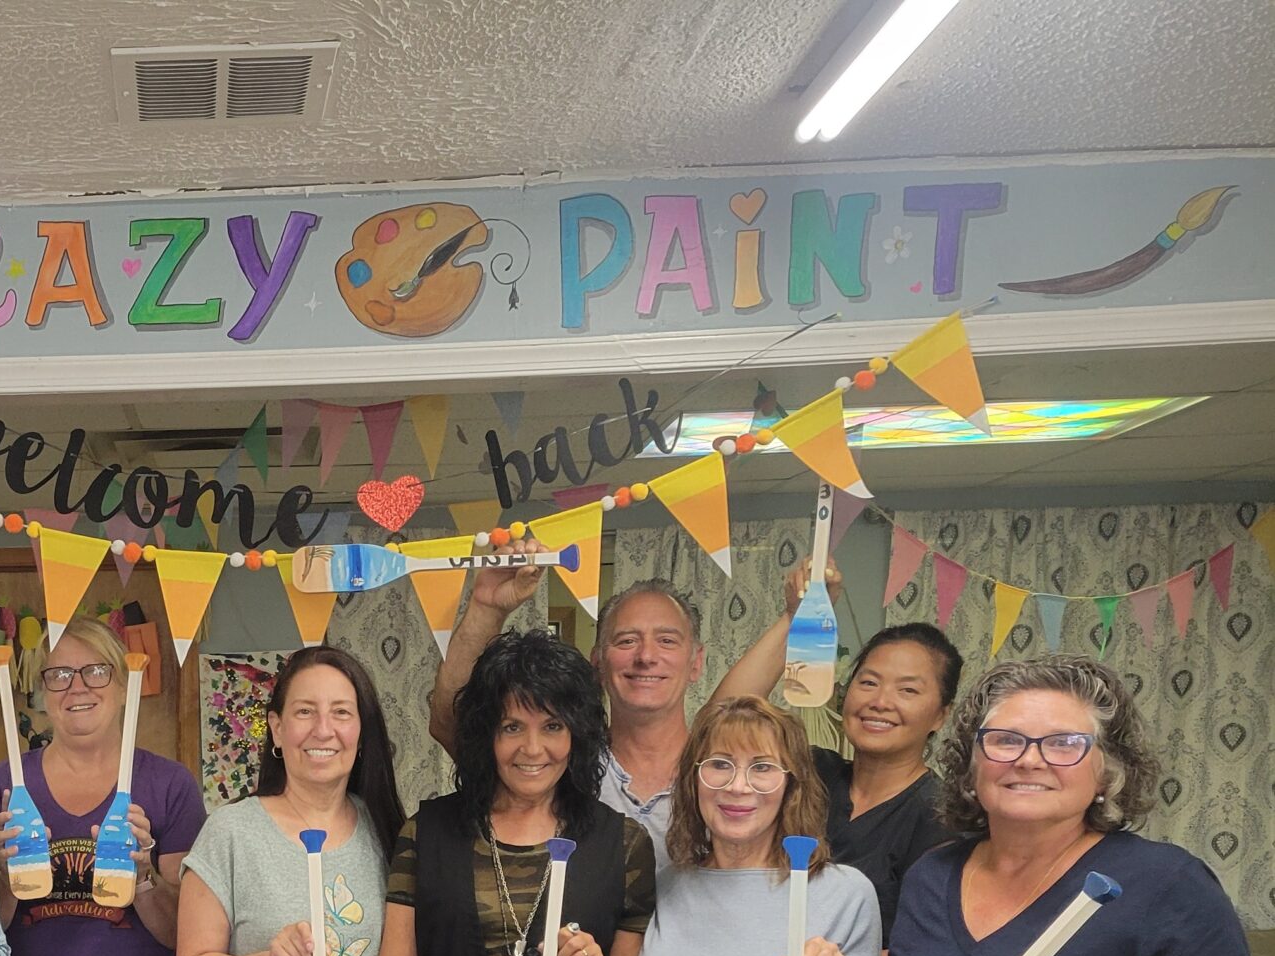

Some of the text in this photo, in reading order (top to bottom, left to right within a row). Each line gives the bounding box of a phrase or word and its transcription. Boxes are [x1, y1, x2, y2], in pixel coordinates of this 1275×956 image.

[486, 378, 683, 509] back
[79, 839, 98, 848] VIST
[42, 902, 115, 918] Adventure
